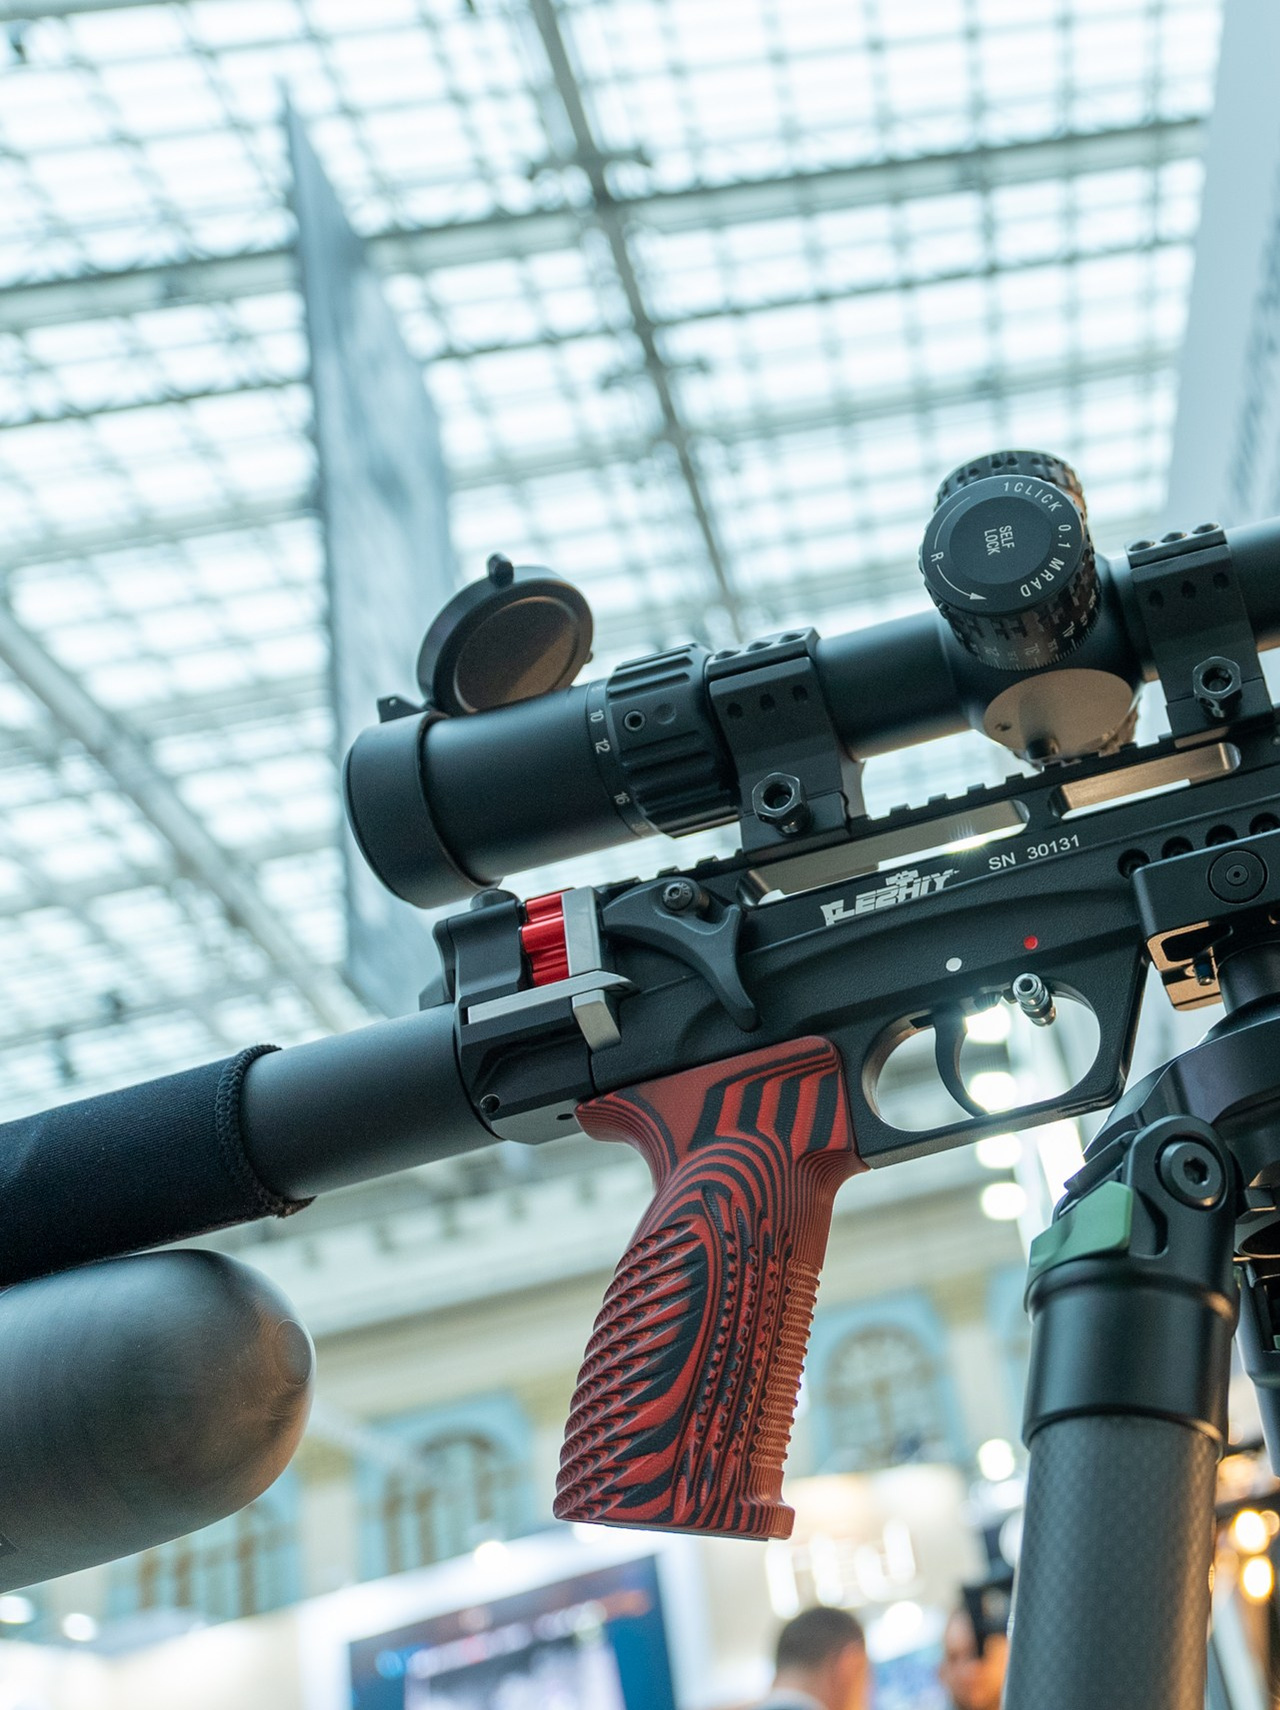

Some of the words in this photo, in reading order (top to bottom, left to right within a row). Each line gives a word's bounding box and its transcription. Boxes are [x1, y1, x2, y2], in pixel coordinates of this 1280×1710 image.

[983, 528, 1001, 556] LOCK
[998, 524, 1016, 549] SELF
[1058, 524, 1072, 549] 0.1
[930, 551, 944, 562] R
[1020, 557, 1065, 598] MRAD
[590, 708, 604, 723] 10
[594, 738, 611, 754] 12
[613, 791, 630, 806] 16
[988, 851, 1016, 871] SN
[1027, 834, 1080, 861] 30131
